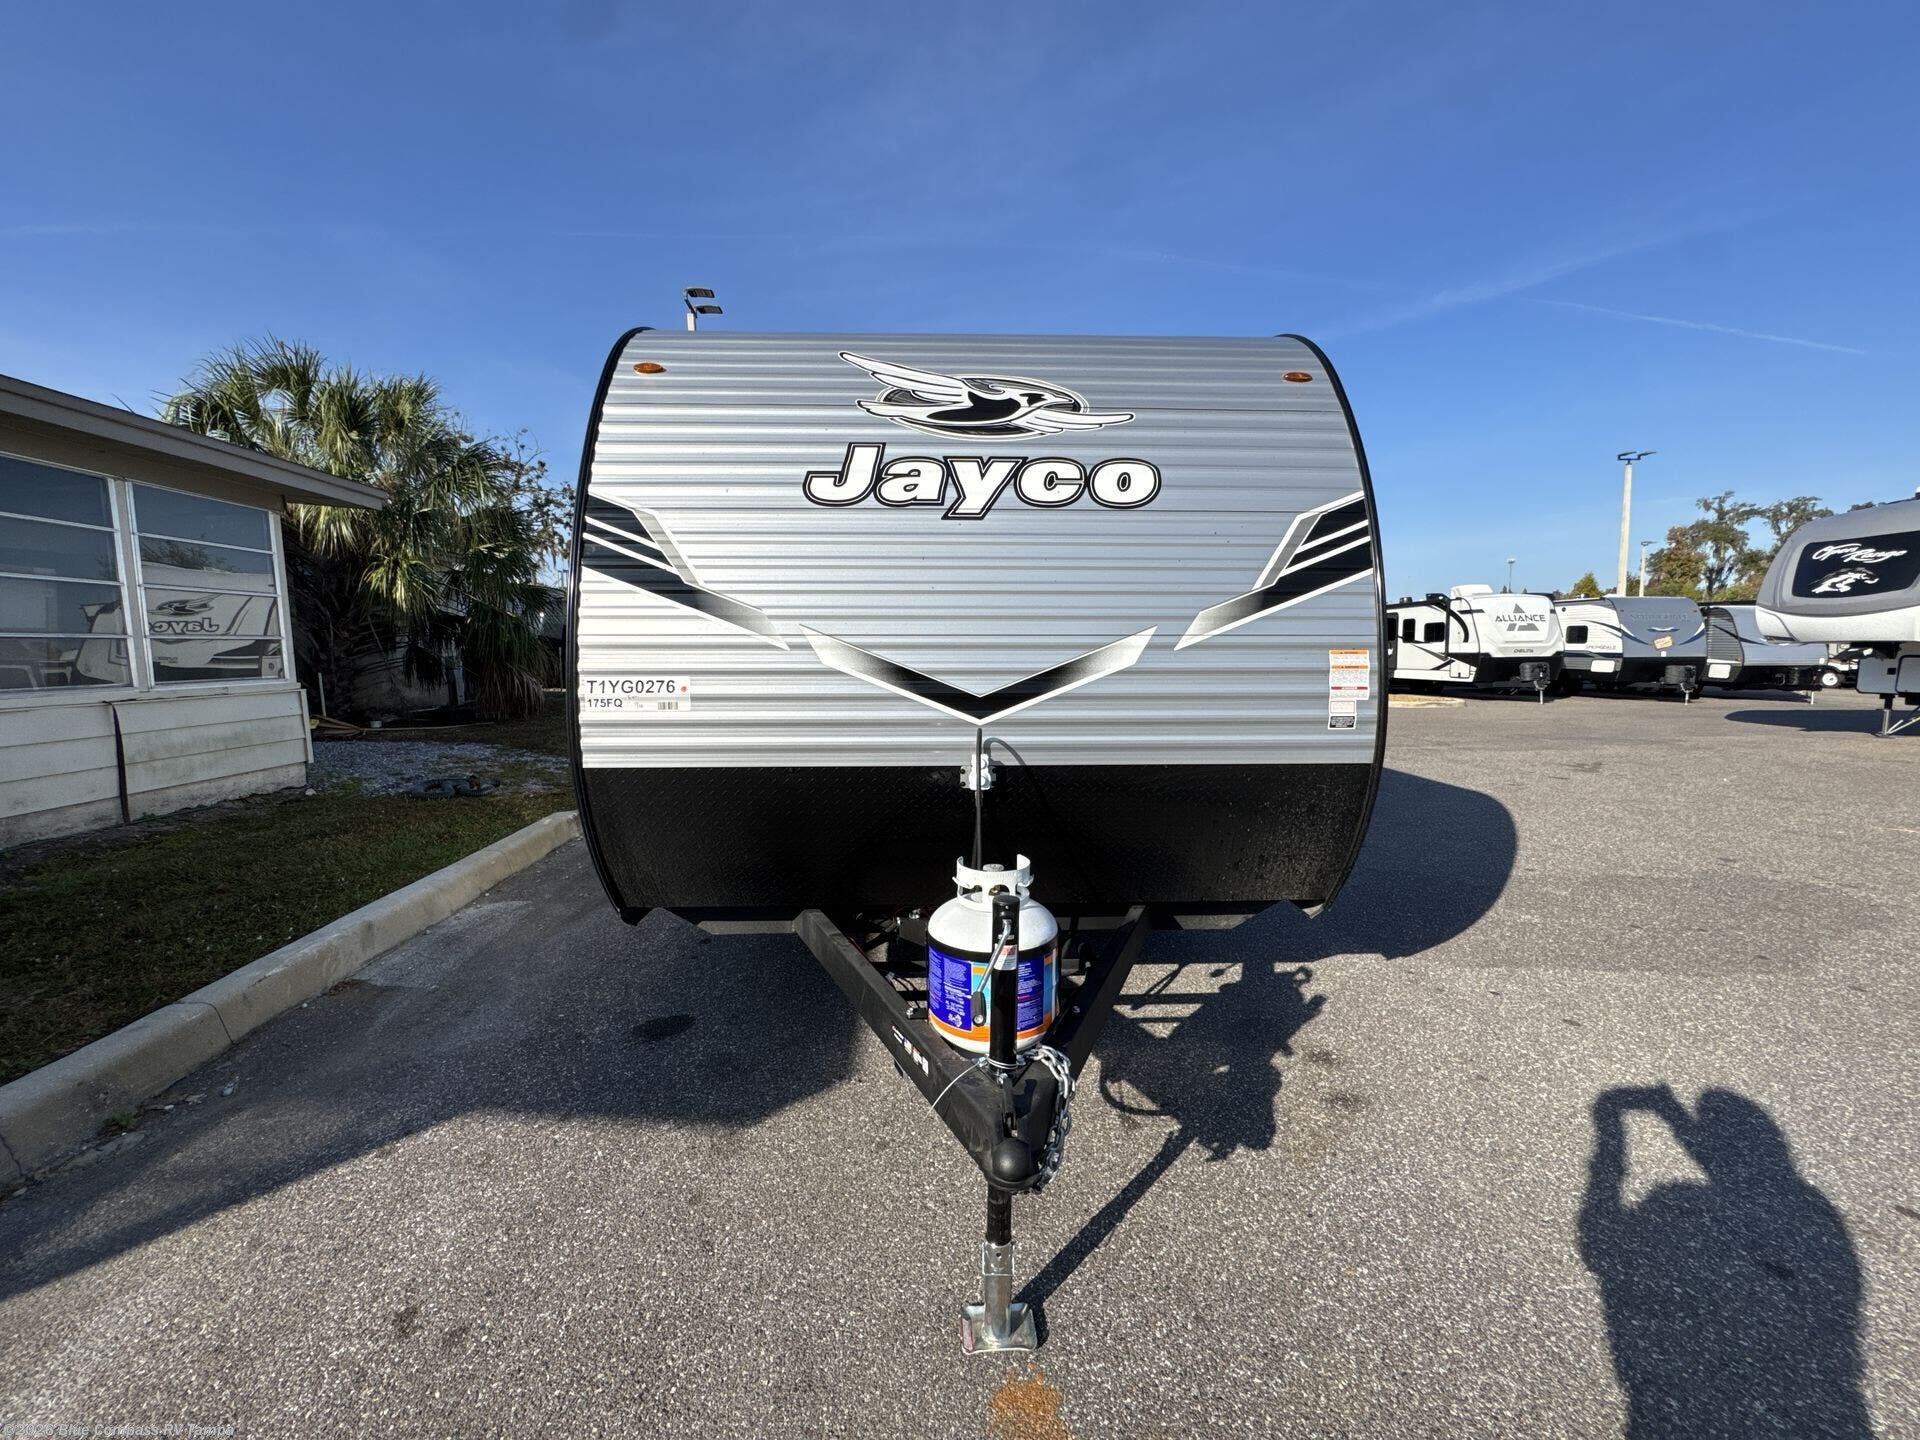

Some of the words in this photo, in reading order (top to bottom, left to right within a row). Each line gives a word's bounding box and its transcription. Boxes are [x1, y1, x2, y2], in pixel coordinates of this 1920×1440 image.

[802, 442, 1162, 520] Jayco
[1495, 614, 1546, 623] ALLIANCE
[586, 680, 676, 694] T1YG0276
[587, 698, 623, 708] 175FQ
